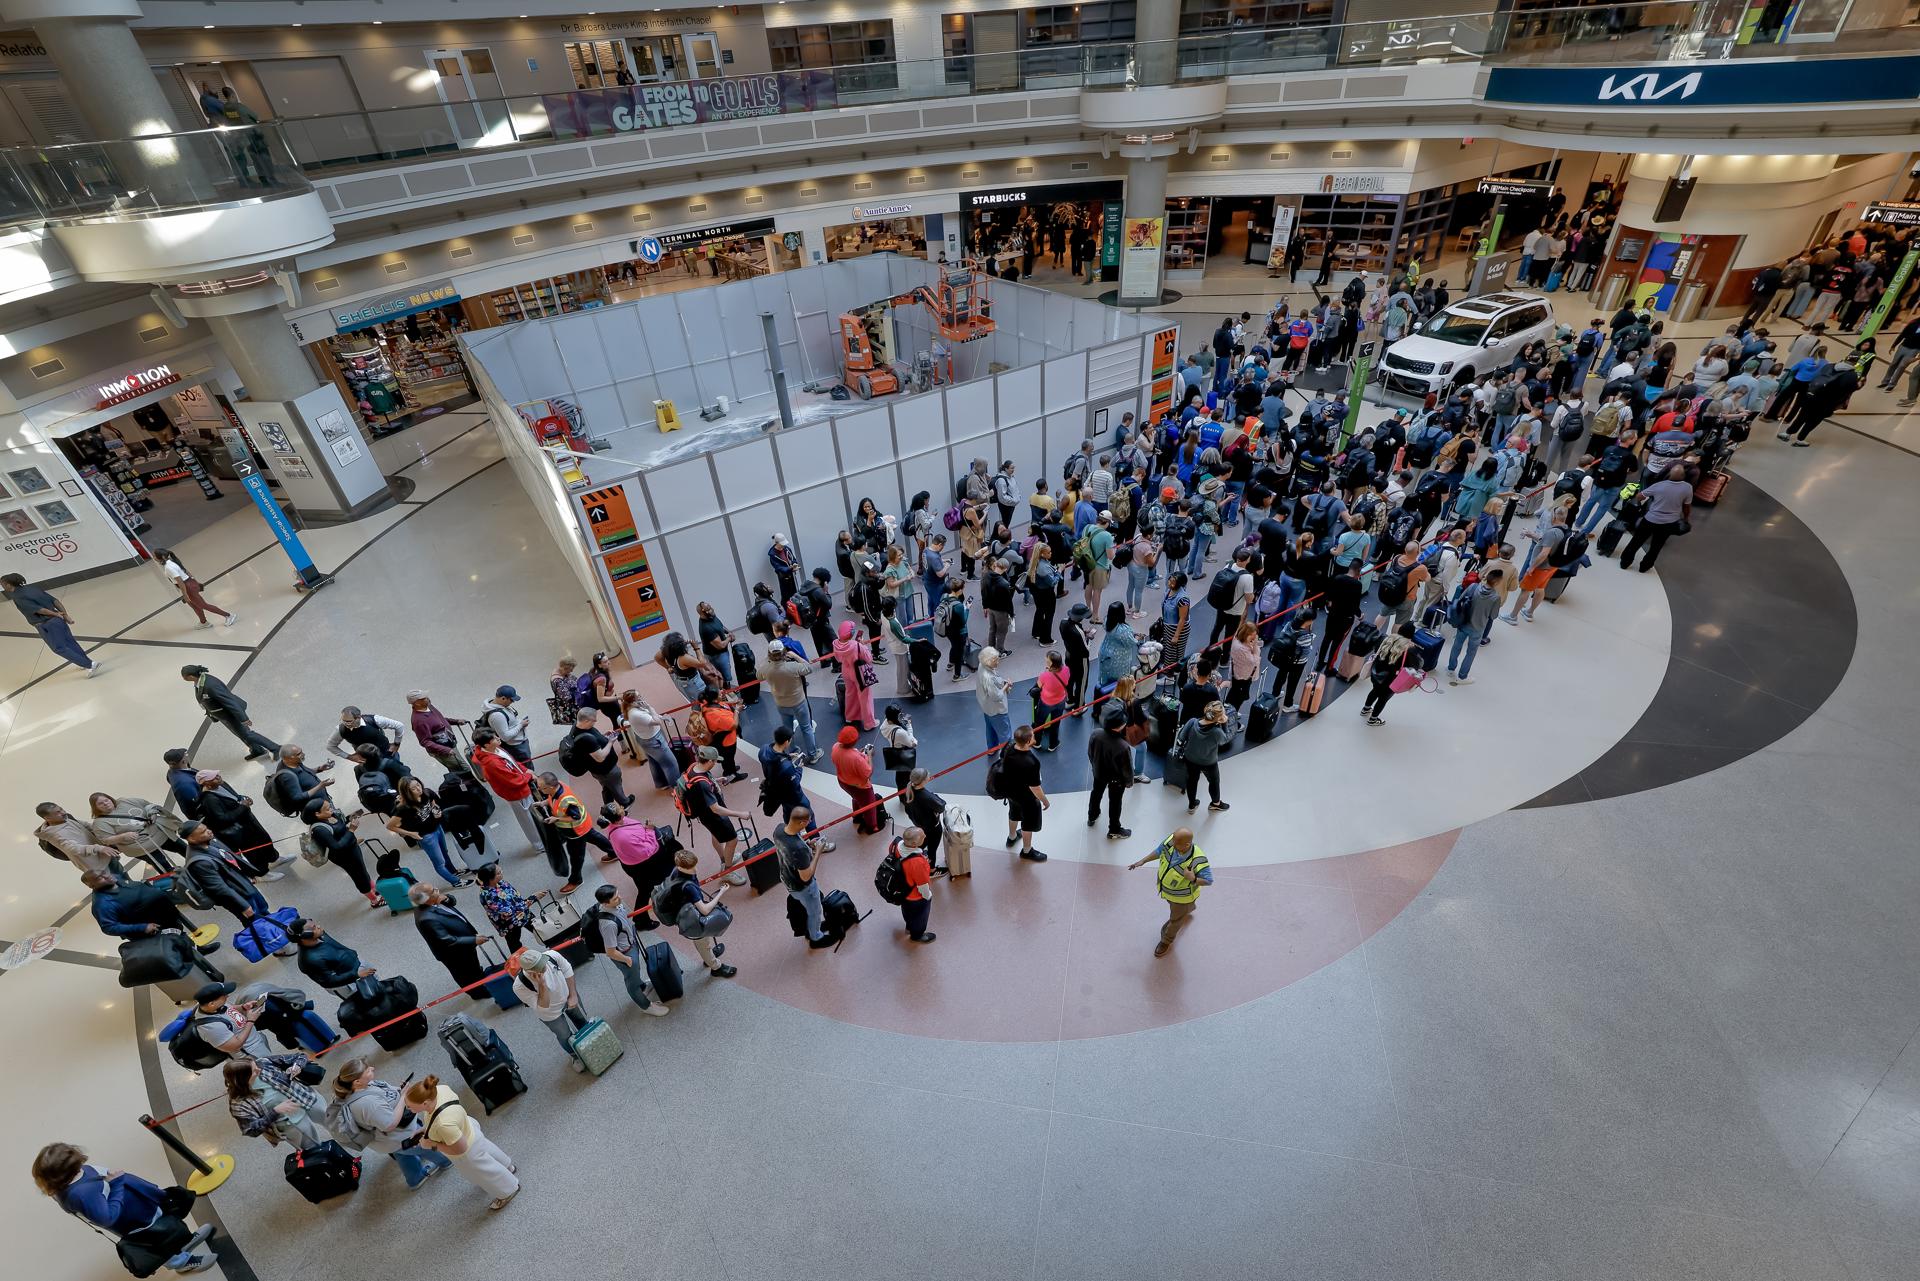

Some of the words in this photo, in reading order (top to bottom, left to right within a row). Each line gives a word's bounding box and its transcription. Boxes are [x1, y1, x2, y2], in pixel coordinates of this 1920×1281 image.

[561, 24, 570, 33] Dr.
[574, 23, 605, 32] Barbara
[607, 21, 629, 31] Lewis
[631, 20, 649, 30] King
[650, 18, 685, 28] Interfaith
[686, 16, 712, 27] Chapel
[642, 84, 691, 104] FROM
[692, 85, 709, 104] TO
[708, 76, 781, 113] GOALS
[1598, 72, 1703, 100] KIA
[612, 99, 698, 132] GATES
[711, 112, 722, 121] AN
[738, 107, 781, 119] EXPERIENCE
[1359, 176, 1385, 192] GRILL
[972, 192, 1027, 205] STARBUCKS
[864, 207, 888, 217] Auntie
[887, 204, 912, 214] Anne's
[1897, 212, 1917, 220] Main
[660, 232, 702, 244] TERMINAL
[704, 226, 732, 237] NORTH
[644, 242, 658, 257] N
[339, 300, 407, 325] SHELLIS
[409, 286, 455, 306] NEWS
[98, 364, 172, 399] INMOTION
[108, 375, 178, 406] ENTERTAINMENT
[257, 488, 278, 519] Assistance
[276, 520, 292, 541] Special
[4, 532, 71, 552] electronics
[25, 548, 39, 556] to
[39, 539, 78, 562] go
